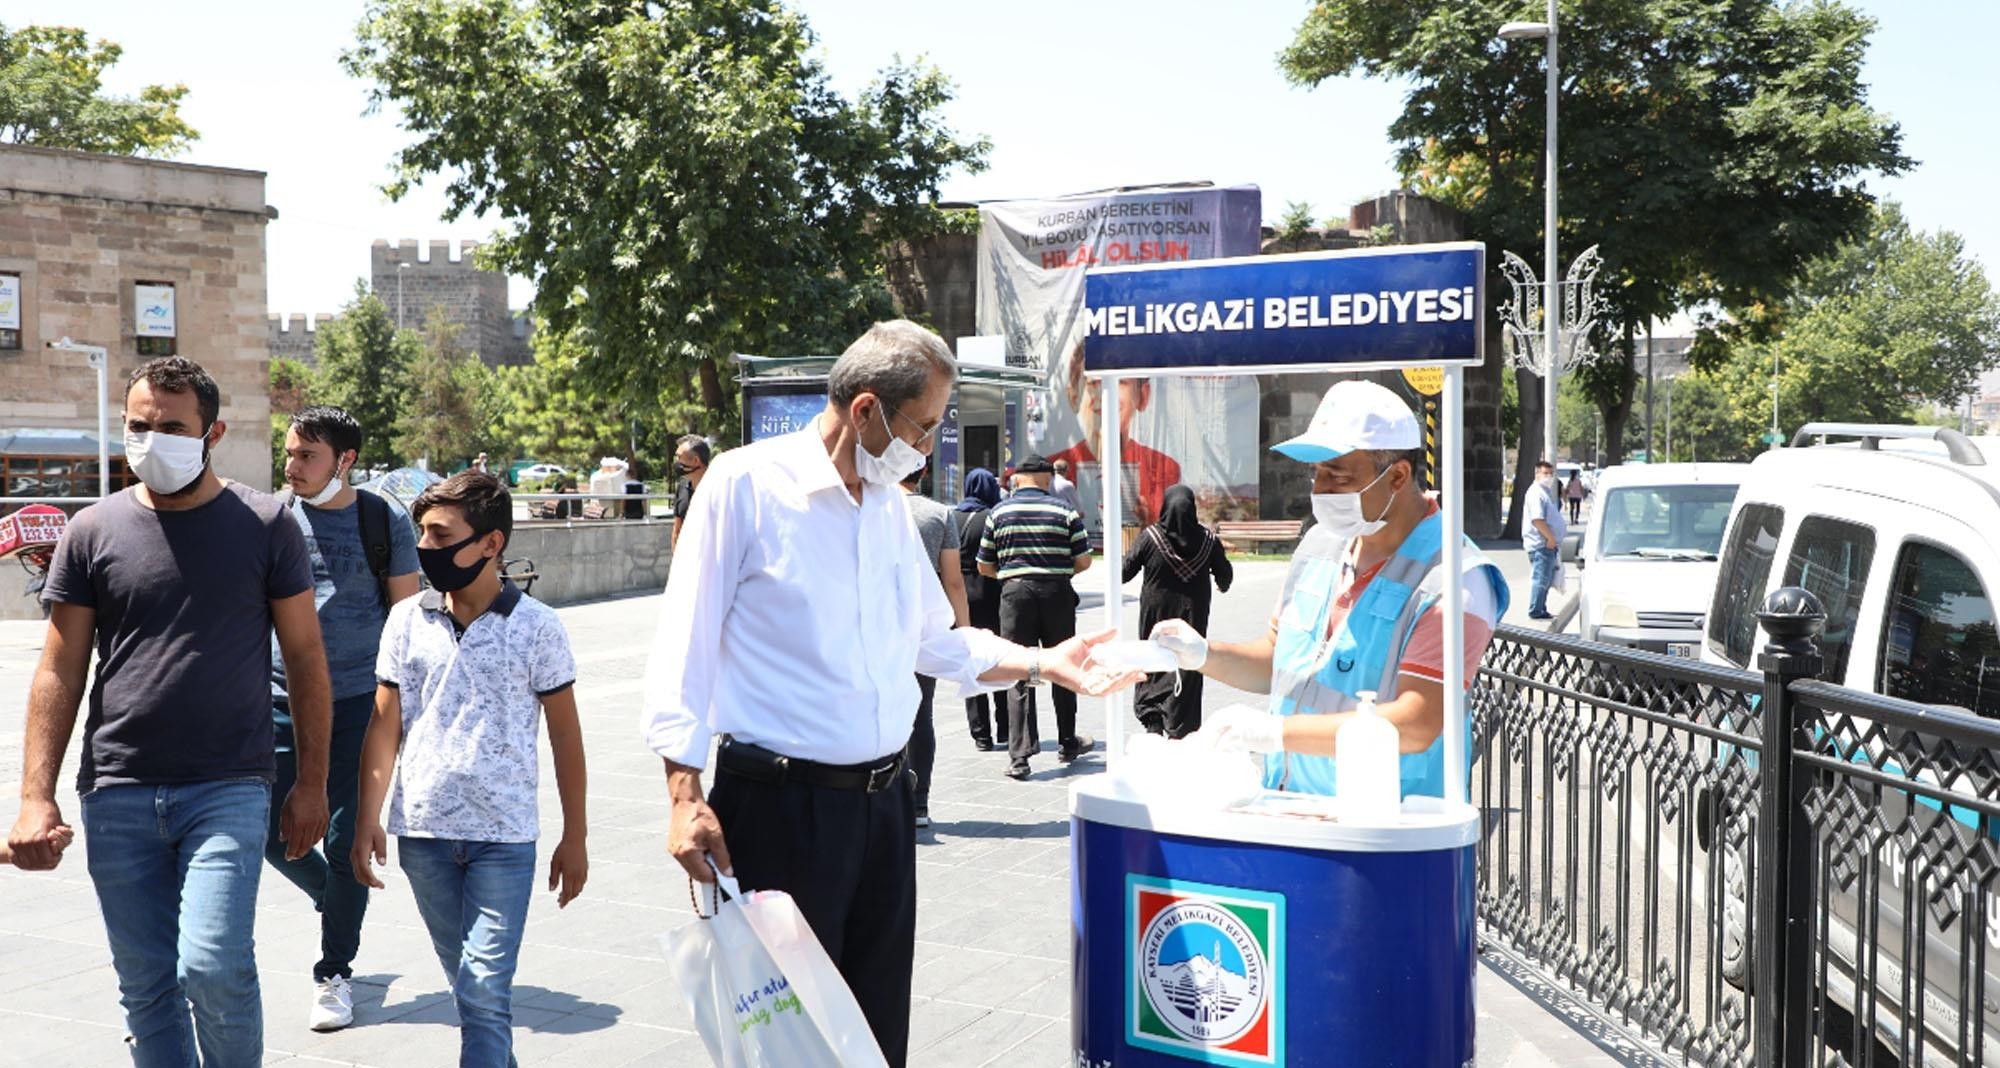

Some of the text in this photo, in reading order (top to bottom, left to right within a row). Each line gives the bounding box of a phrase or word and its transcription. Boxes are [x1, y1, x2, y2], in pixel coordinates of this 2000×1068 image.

[1038, 207, 1096, 228] KURBAN
[1047, 227, 1088, 245] BOYU
[1105, 240, 1190, 262] OLSUN
[1677, 646, 1690, 657] 38
